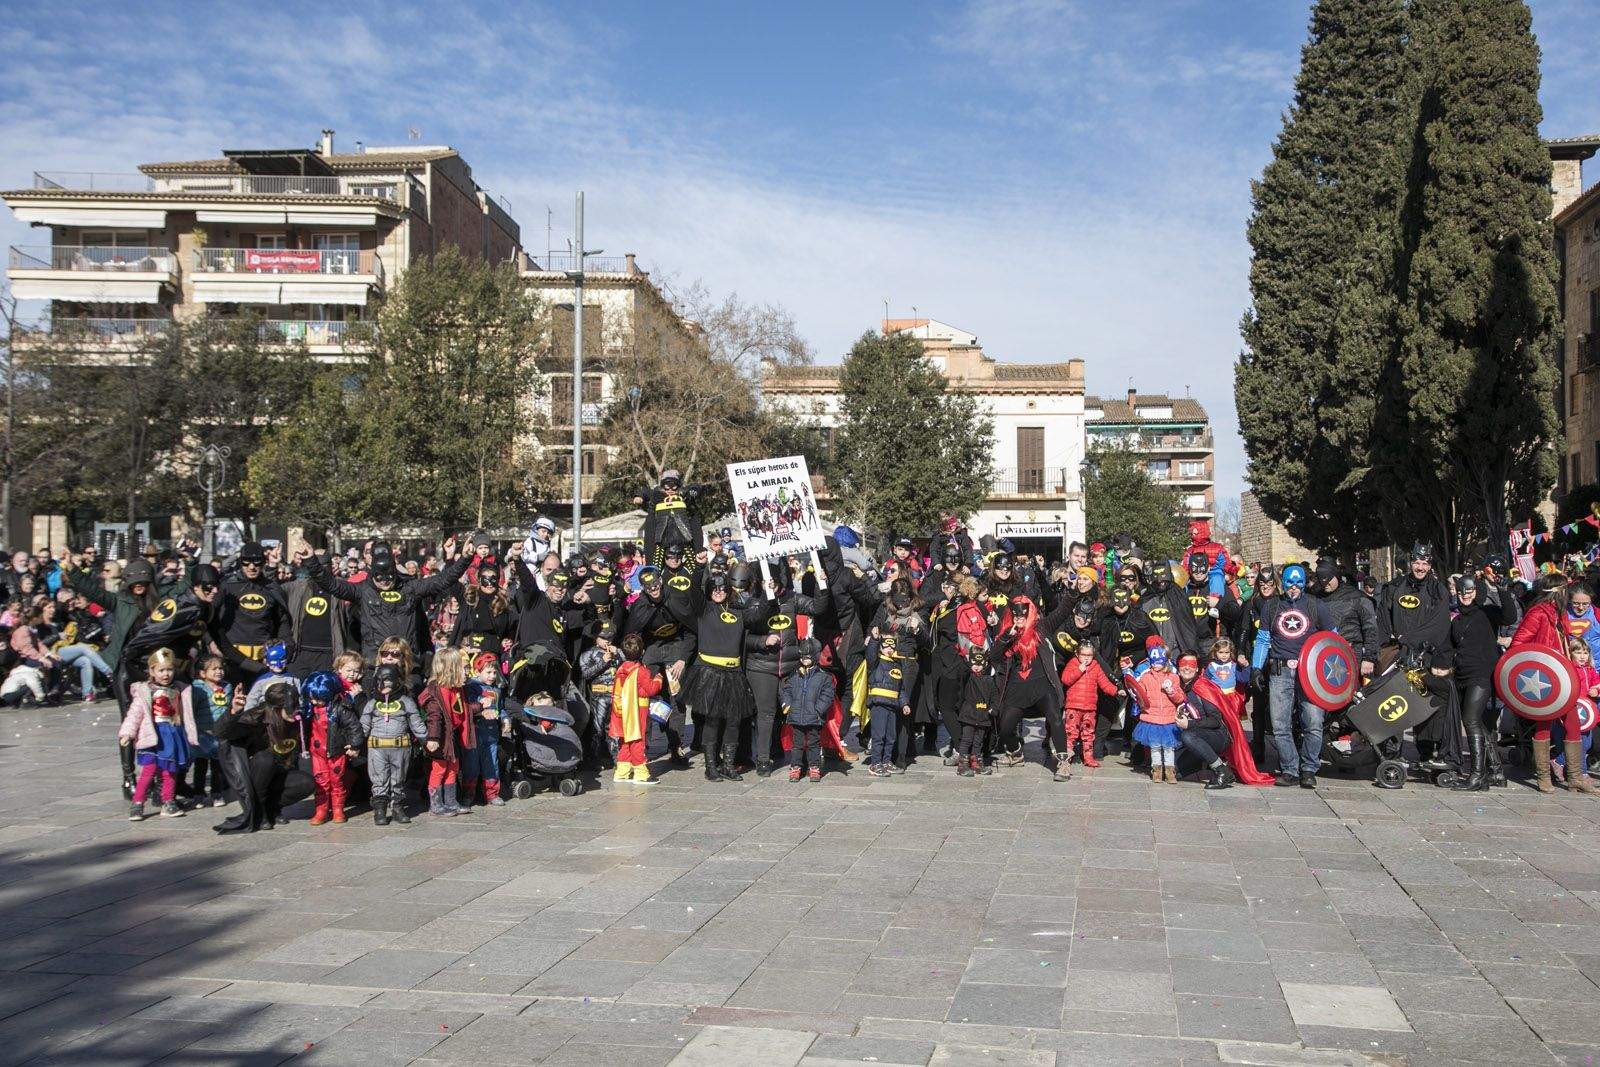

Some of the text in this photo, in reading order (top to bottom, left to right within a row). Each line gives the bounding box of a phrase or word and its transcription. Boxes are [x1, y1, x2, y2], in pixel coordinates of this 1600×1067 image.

[735, 468, 746, 476] Els
[748, 466, 766, 475] súper
[768, 463, 789, 471] herois
[747, 476, 794, 489] LA MIRADA
[769, 531, 800, 546] HEROES
